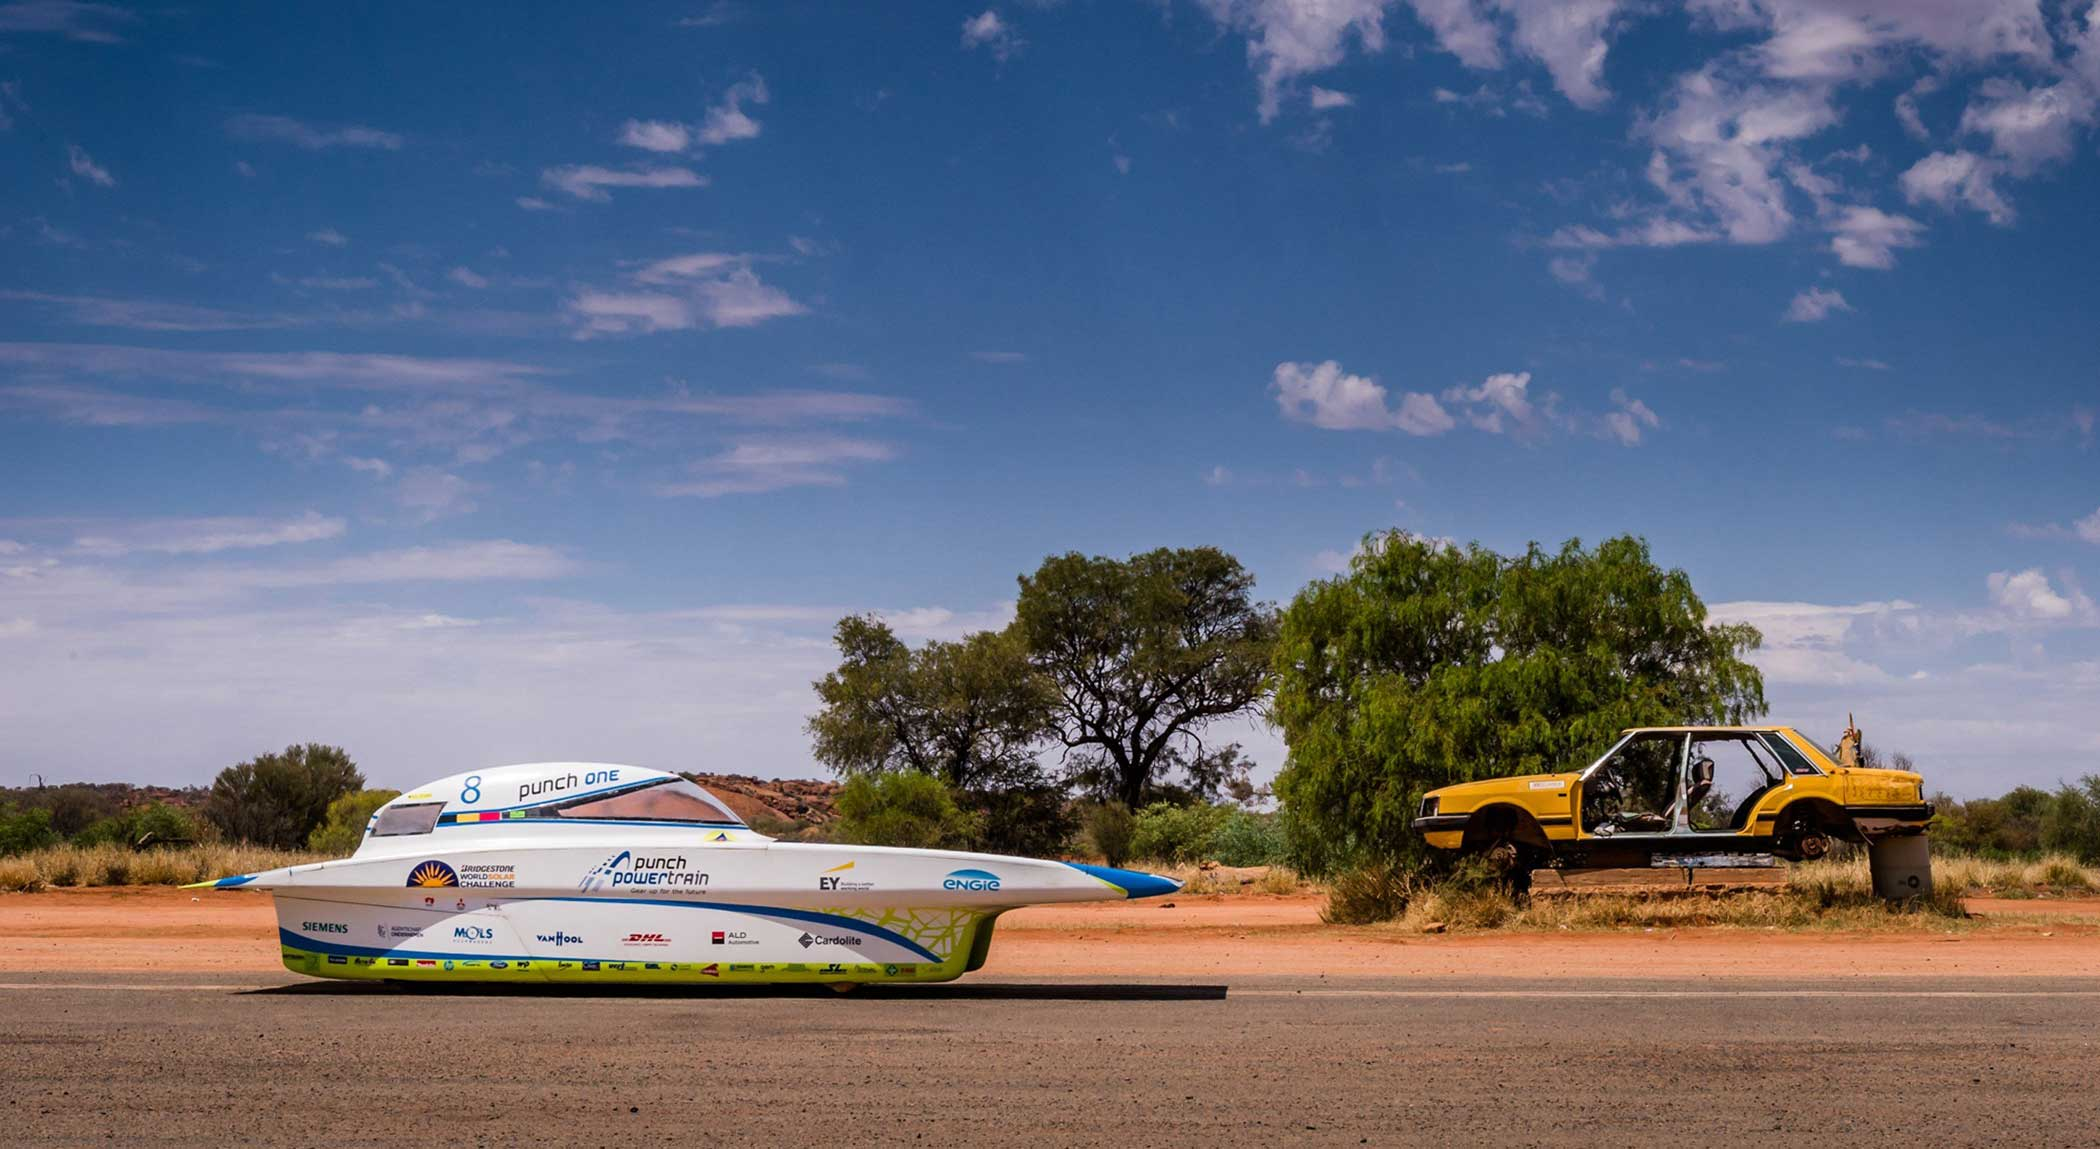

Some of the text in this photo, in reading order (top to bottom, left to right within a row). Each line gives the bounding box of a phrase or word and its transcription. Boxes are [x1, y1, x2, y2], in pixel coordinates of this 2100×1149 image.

[461, 776, 481, 804] 8
[519, 773, 578, 802] punch
[461, 864, 515, 873] BRIDGESTONE
[634, 856, 687, 871] punch
[460, 880, 515, 888] CHALLENGE
[819, 877, 840, 890] EY
[302, 921, 348, 934] SIEMENS
[454, 926, 493, 940] MOLS
[628, 934, 664, 942] DHL
[815, 936, 862, 946] Cardolite
